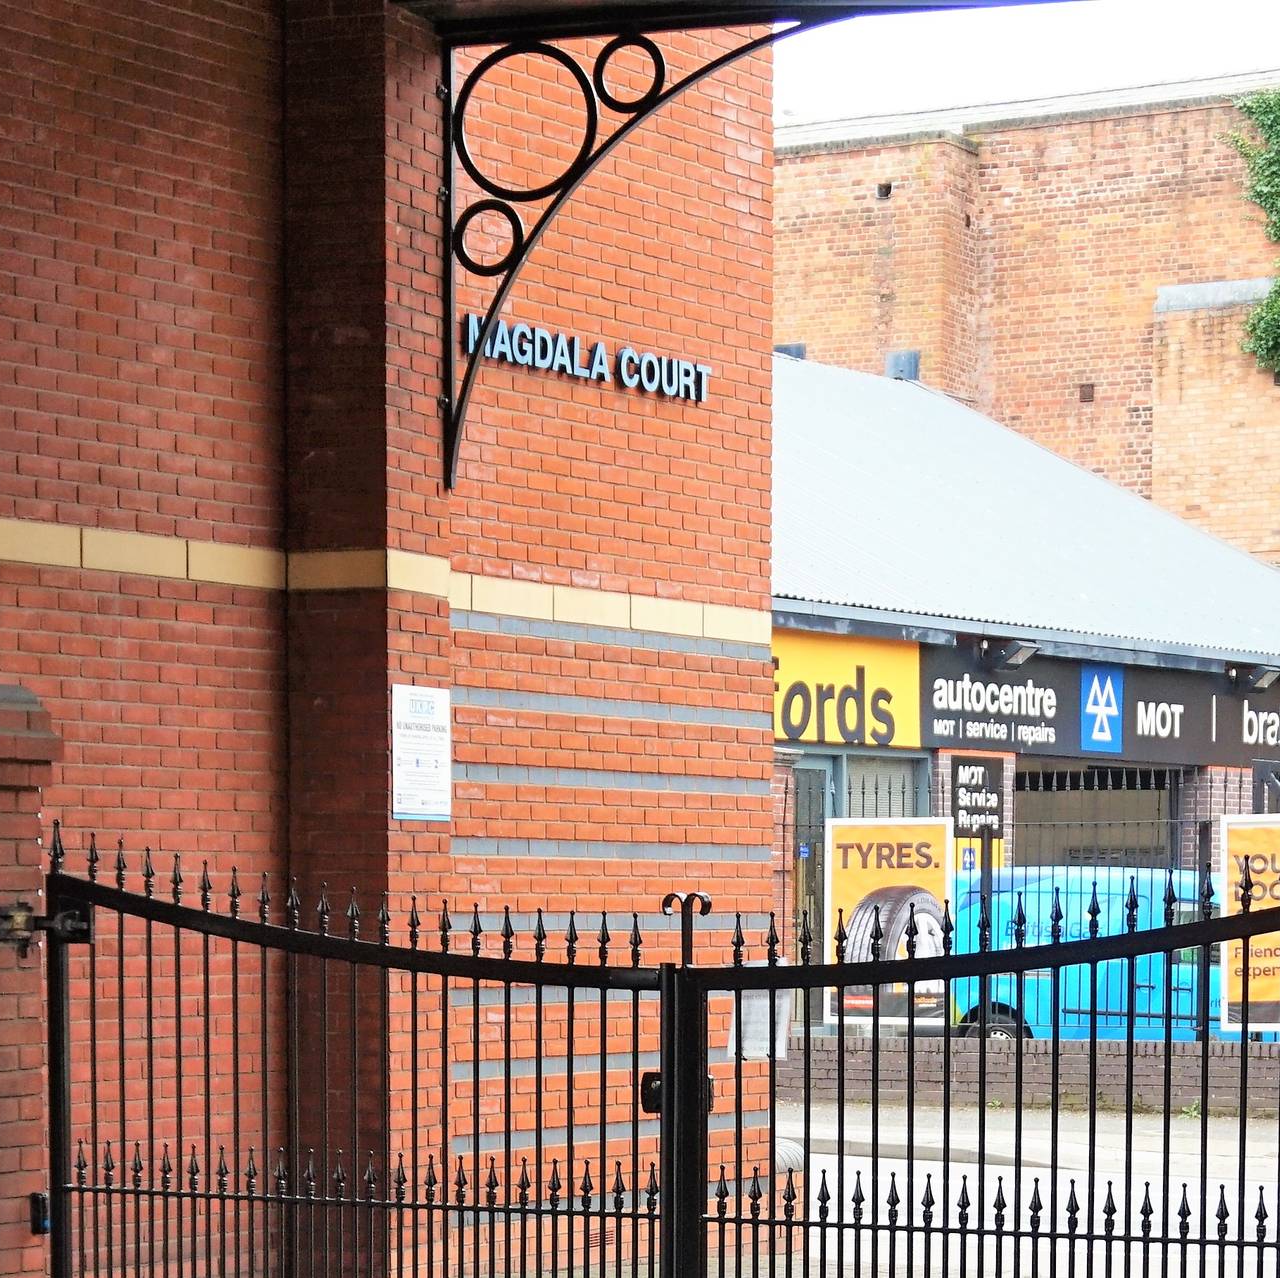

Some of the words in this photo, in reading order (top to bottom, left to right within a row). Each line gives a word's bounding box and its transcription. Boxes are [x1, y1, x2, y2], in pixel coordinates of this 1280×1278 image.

[467, 313, 612, 383] MAGDALA
[618, 346, 712, 403] COURT
[772, 656, 896, 746] ords
[932, 673, 1057, 719] autocentre
[932, 717, 956, 737] MOT
[966, 717, 1008, 740] service
[1017, 721, 1056, 746] repairs
[1136, 700, 1184, 739] MOT
[958, 765, 985, 786] MOT
[836, 842, 941, 870] TYRES.
